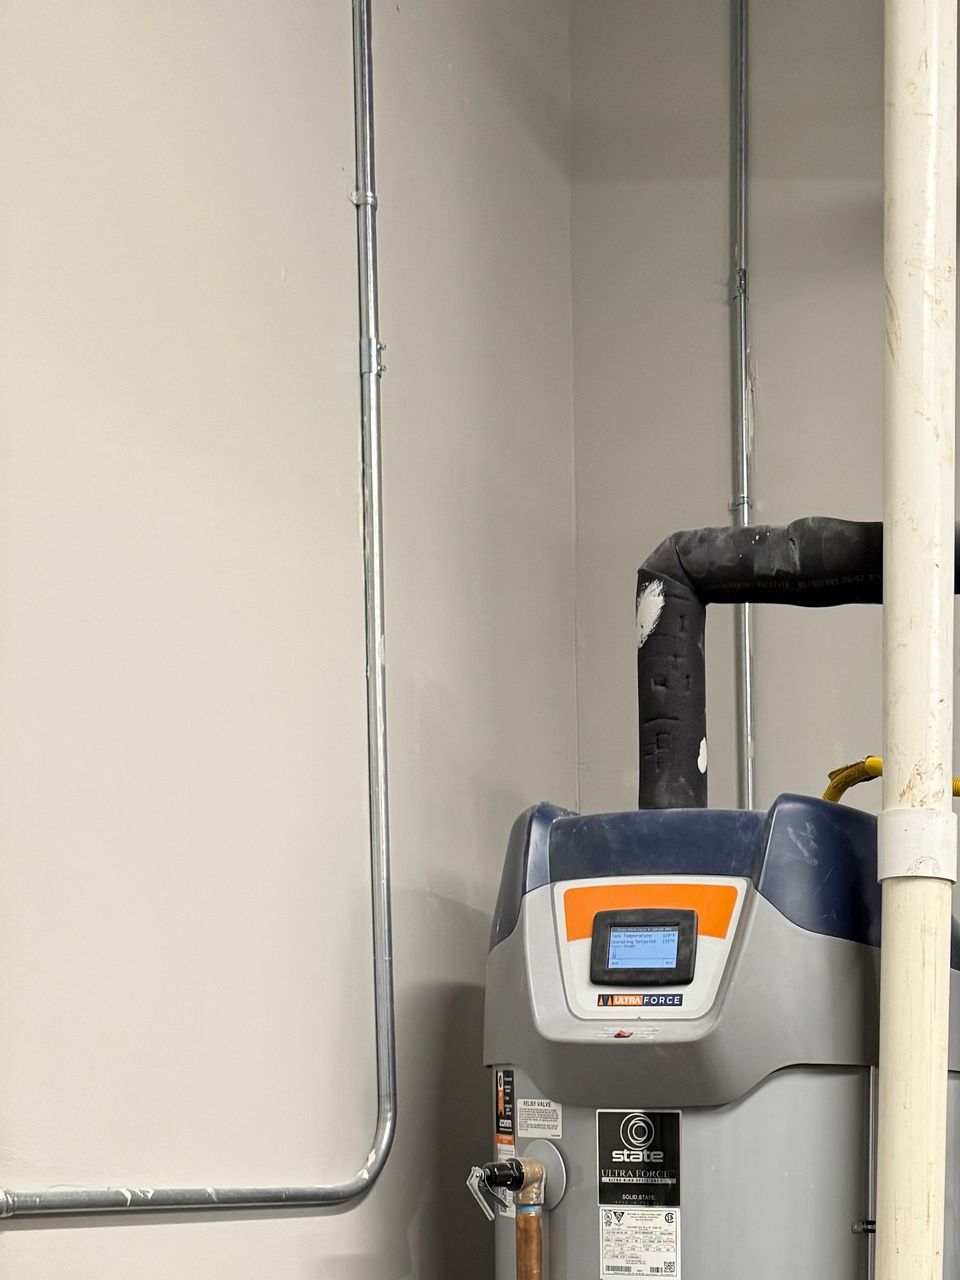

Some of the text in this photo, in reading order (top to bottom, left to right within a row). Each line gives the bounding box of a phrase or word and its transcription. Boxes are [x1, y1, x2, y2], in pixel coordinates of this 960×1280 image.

[643, 996, 681, 1004] FORCE
[612, 1149, 664, 1162] state
[601, 1169, 633, 1177] ULTRA
